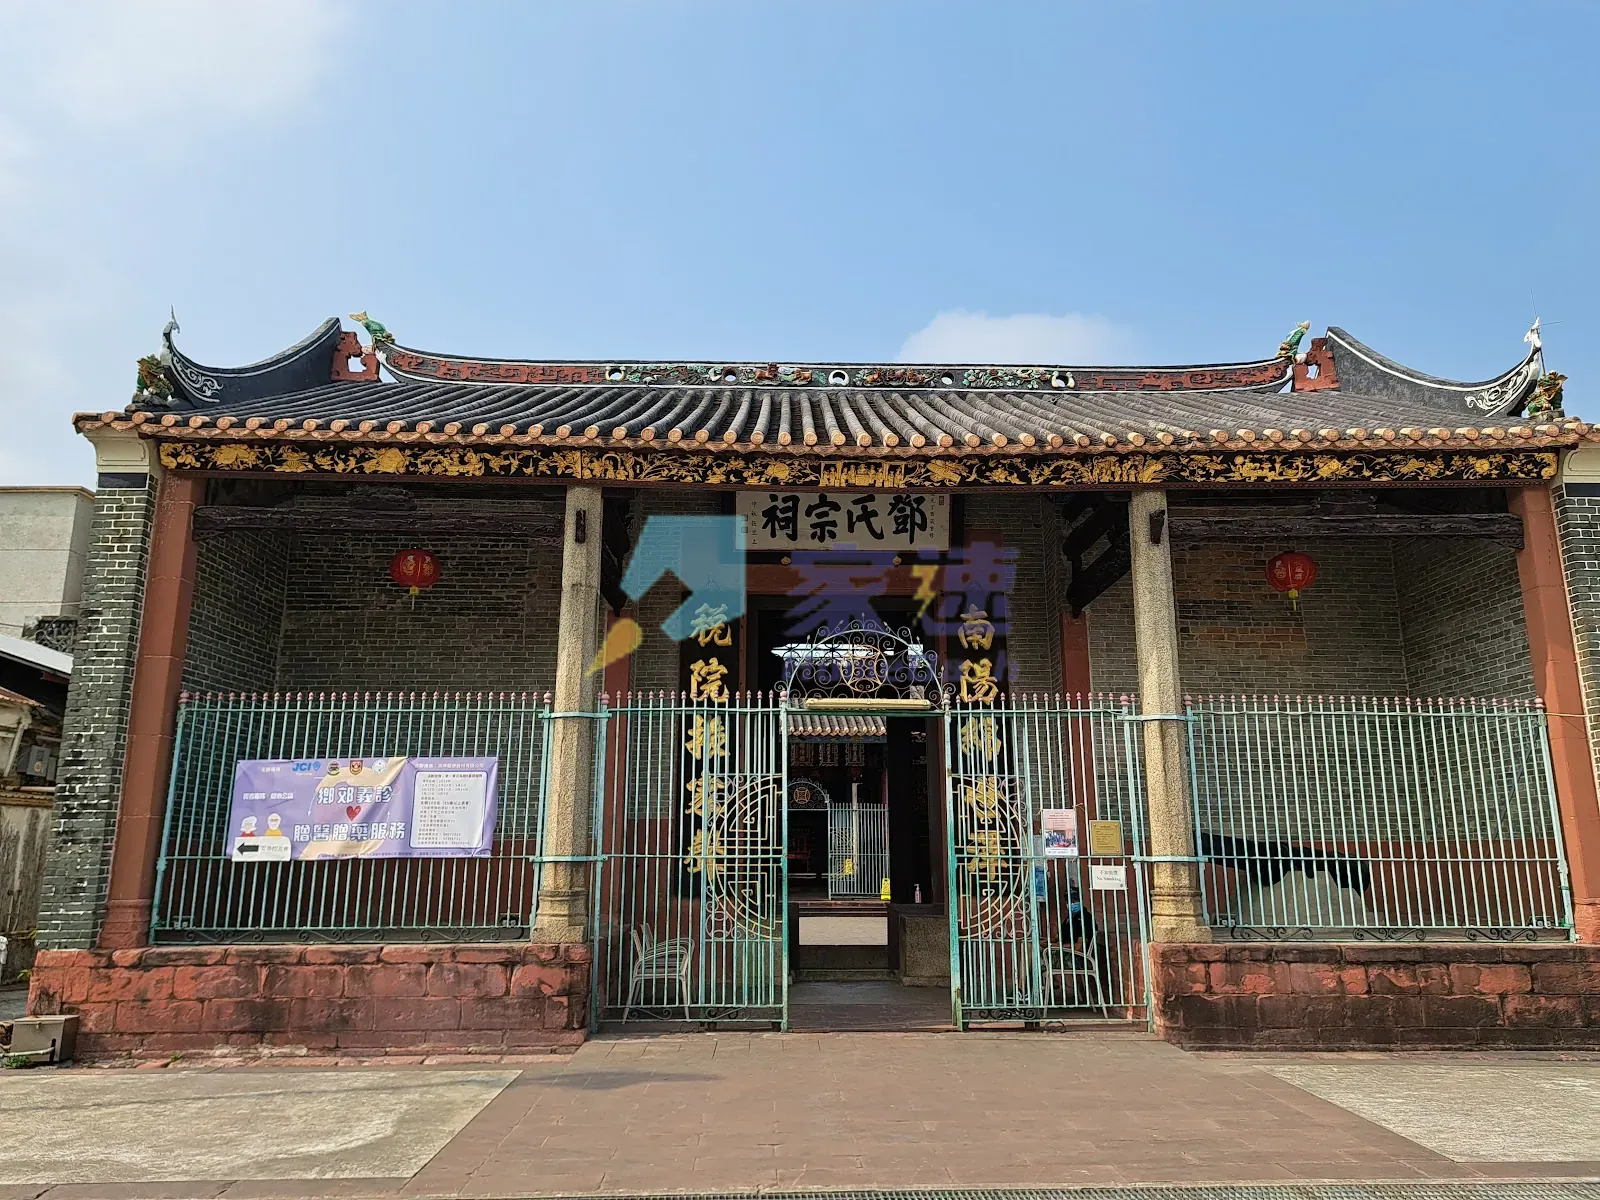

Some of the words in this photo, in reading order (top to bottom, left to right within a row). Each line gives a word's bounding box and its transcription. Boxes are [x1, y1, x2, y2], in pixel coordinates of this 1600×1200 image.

[292, 762, 312, 772] JCI
[317, 785, 393, 805] 鄉郊義診
[293, 821, 406, 842] 贈醫贈藥服務
